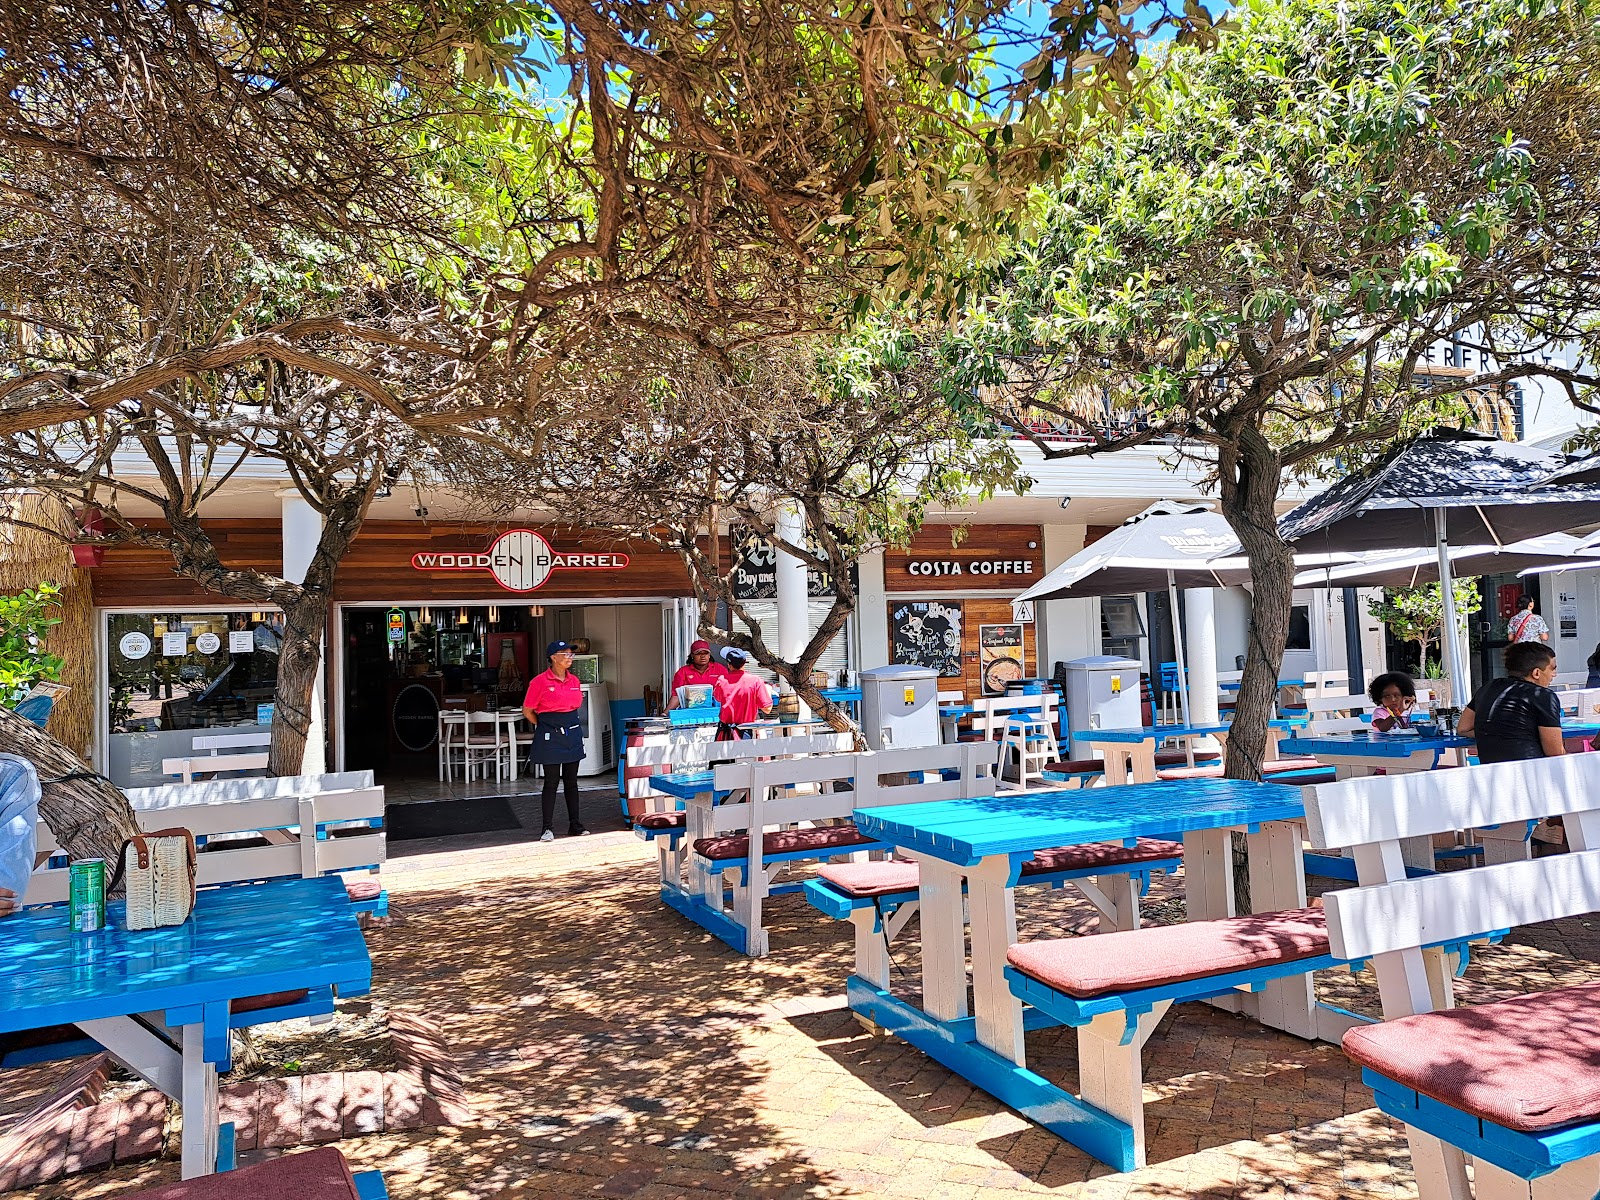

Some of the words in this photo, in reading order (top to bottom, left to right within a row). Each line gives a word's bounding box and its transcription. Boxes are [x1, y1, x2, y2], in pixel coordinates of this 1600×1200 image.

[417, 555, 523, 567] WOODEN
[536, 555, 624, 567] BARREL
[909, 561, 963, 576] COSTA
[969, 560, 1033, 575] COFFEE
[1336, 594, 1369, 603] SEITY
[894, 605, 909, 620] OFF
[912, 602, 929, 611] THE
